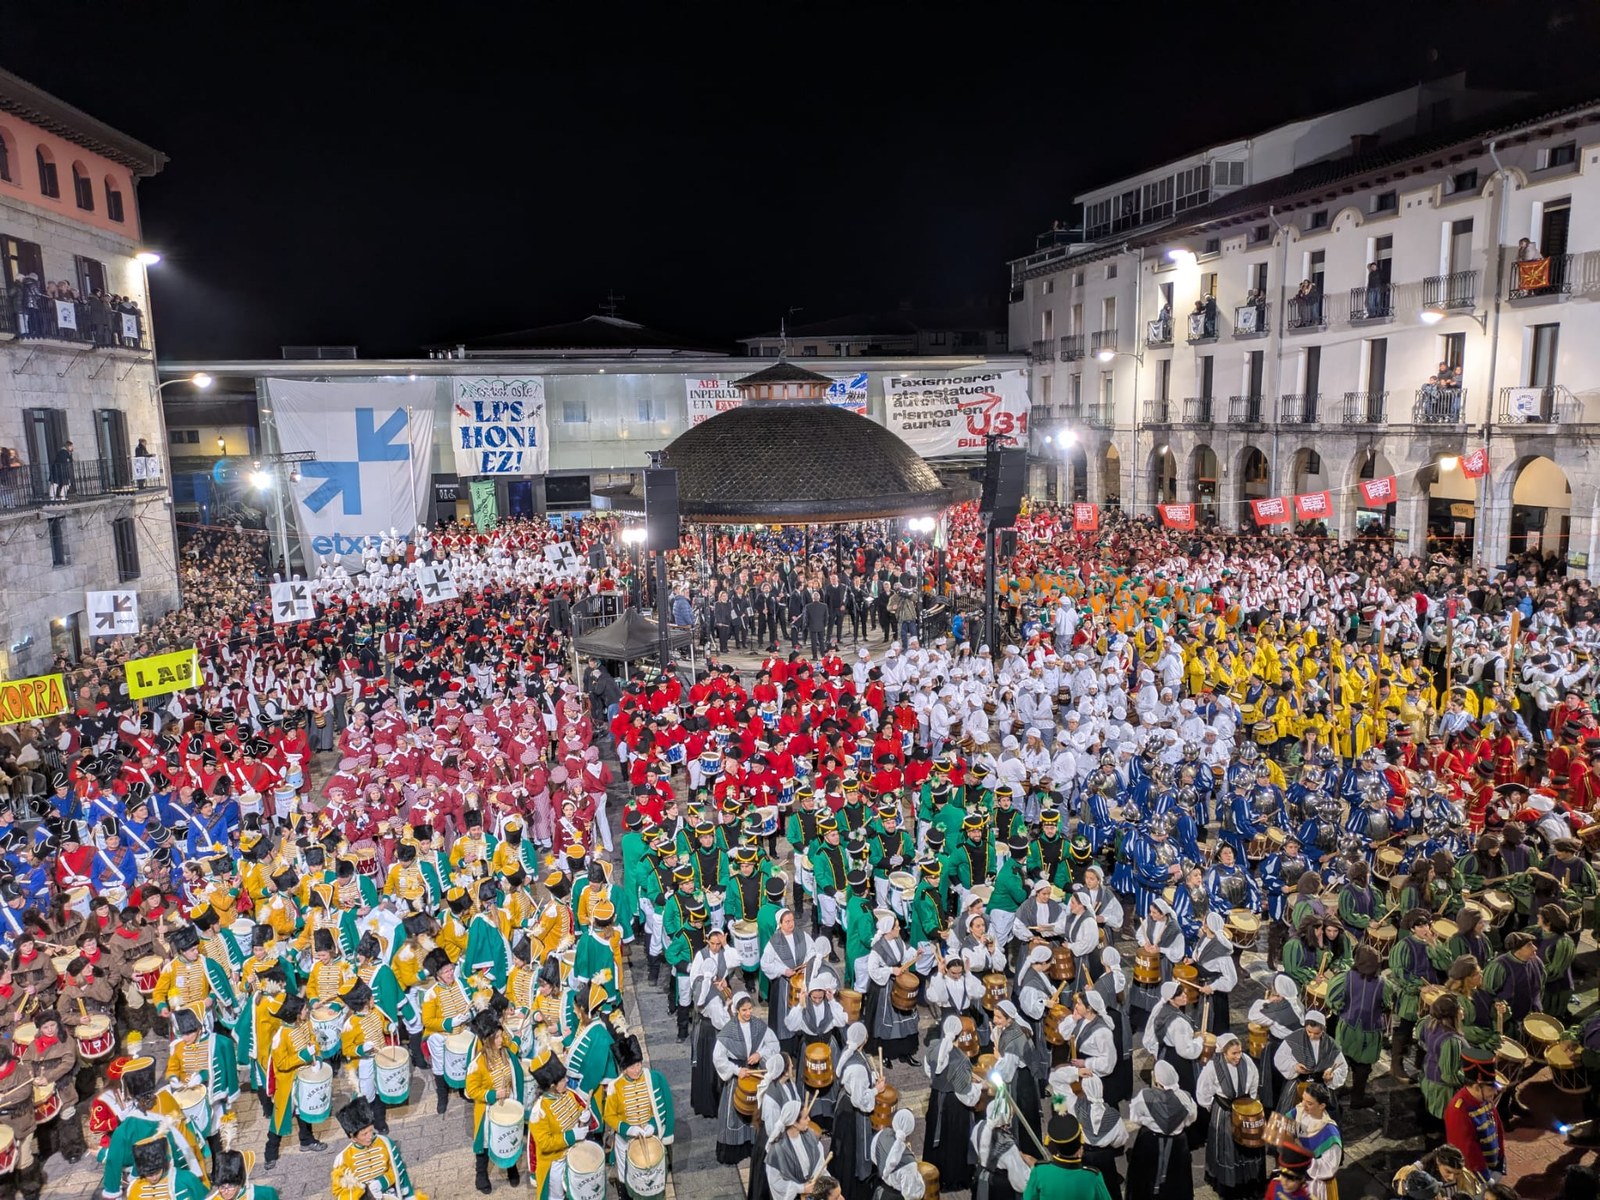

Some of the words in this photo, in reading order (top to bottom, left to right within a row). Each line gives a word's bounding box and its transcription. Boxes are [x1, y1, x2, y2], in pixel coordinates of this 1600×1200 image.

[891, 373, 1002, 388] Faxismoaren
[690, 389, 743, 398] INPERIALI
[829, 383, 846, 397] 43
[922, 385, 995, 398] estatuen
[474, 401, 525, 422] LPS
[693, 400, 713, 409] ETA
[893, 406, 983, 420] rismoaren
[902, 420, 951, 430] aurka
[967, 411, 1028, 436] U31
[459, 425, 537, 449] HONI
[481, 451, 524, 473] EZ!
